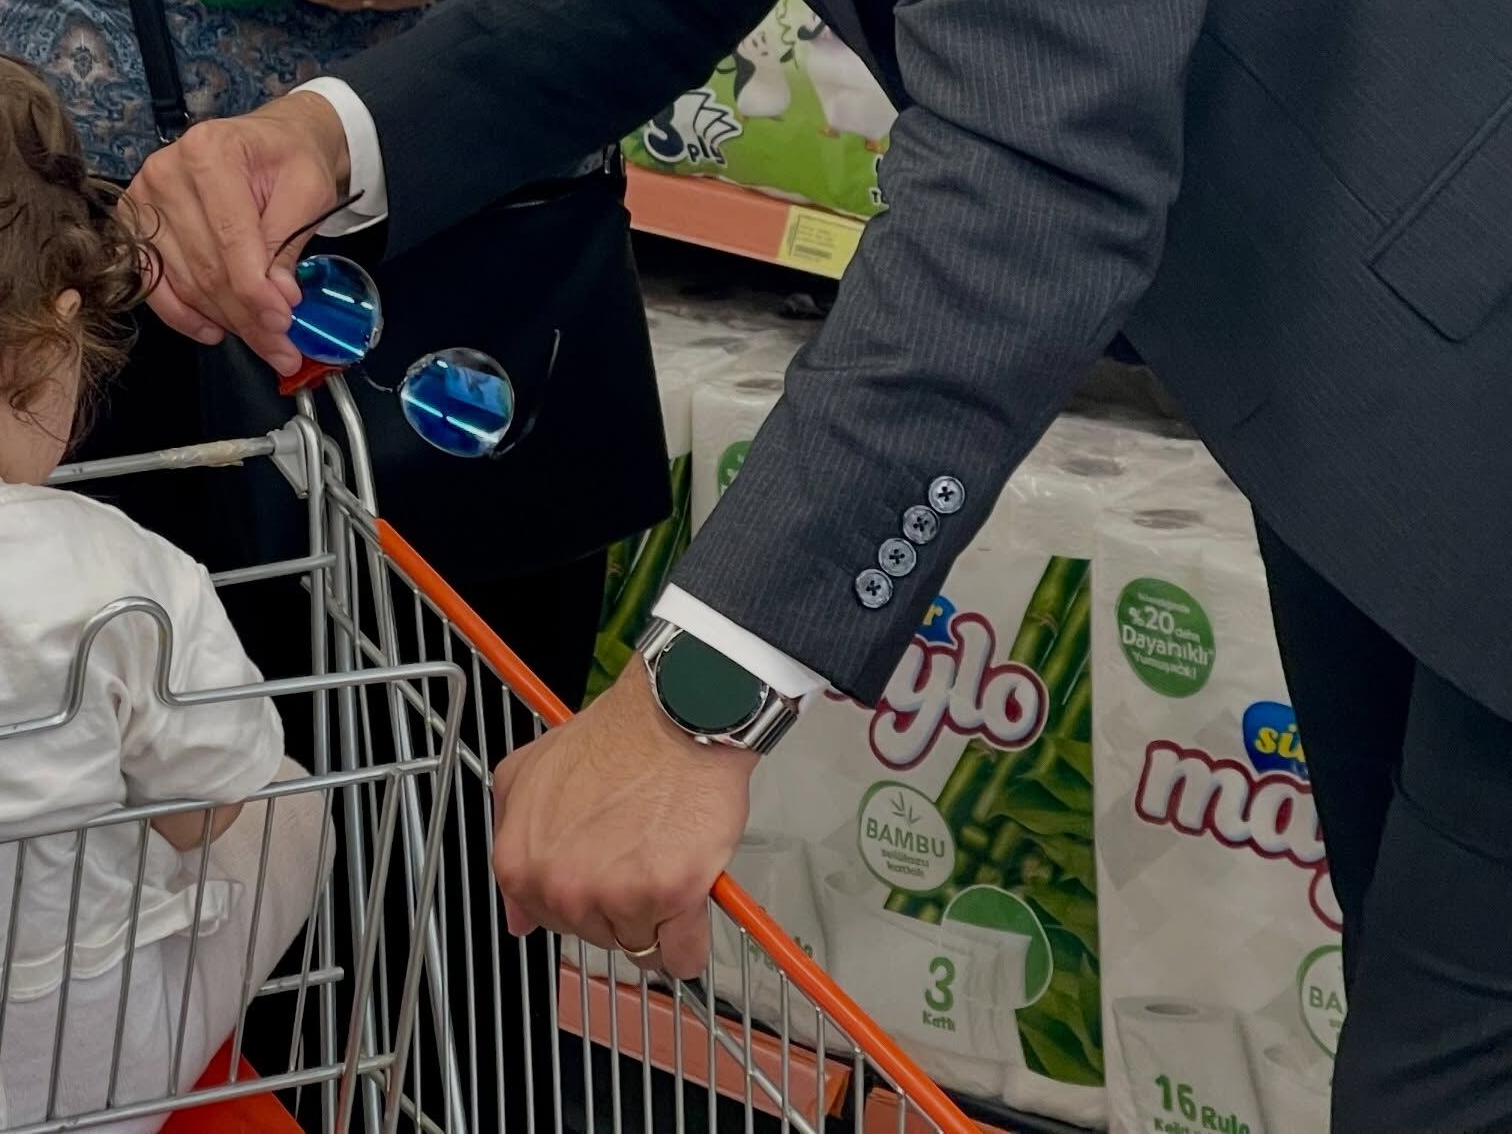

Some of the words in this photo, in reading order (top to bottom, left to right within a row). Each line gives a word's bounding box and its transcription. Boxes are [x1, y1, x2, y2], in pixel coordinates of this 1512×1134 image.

[687, 133, 727, 167] ply
[869, 612, 1048, 770] ylo
[866, 817, 945, 858] BAMBU
[924, 956, 956, 1012] 3
[1309, 985, 1343, 1014] BA
[1155, 1074, 1197, 1122] 16
